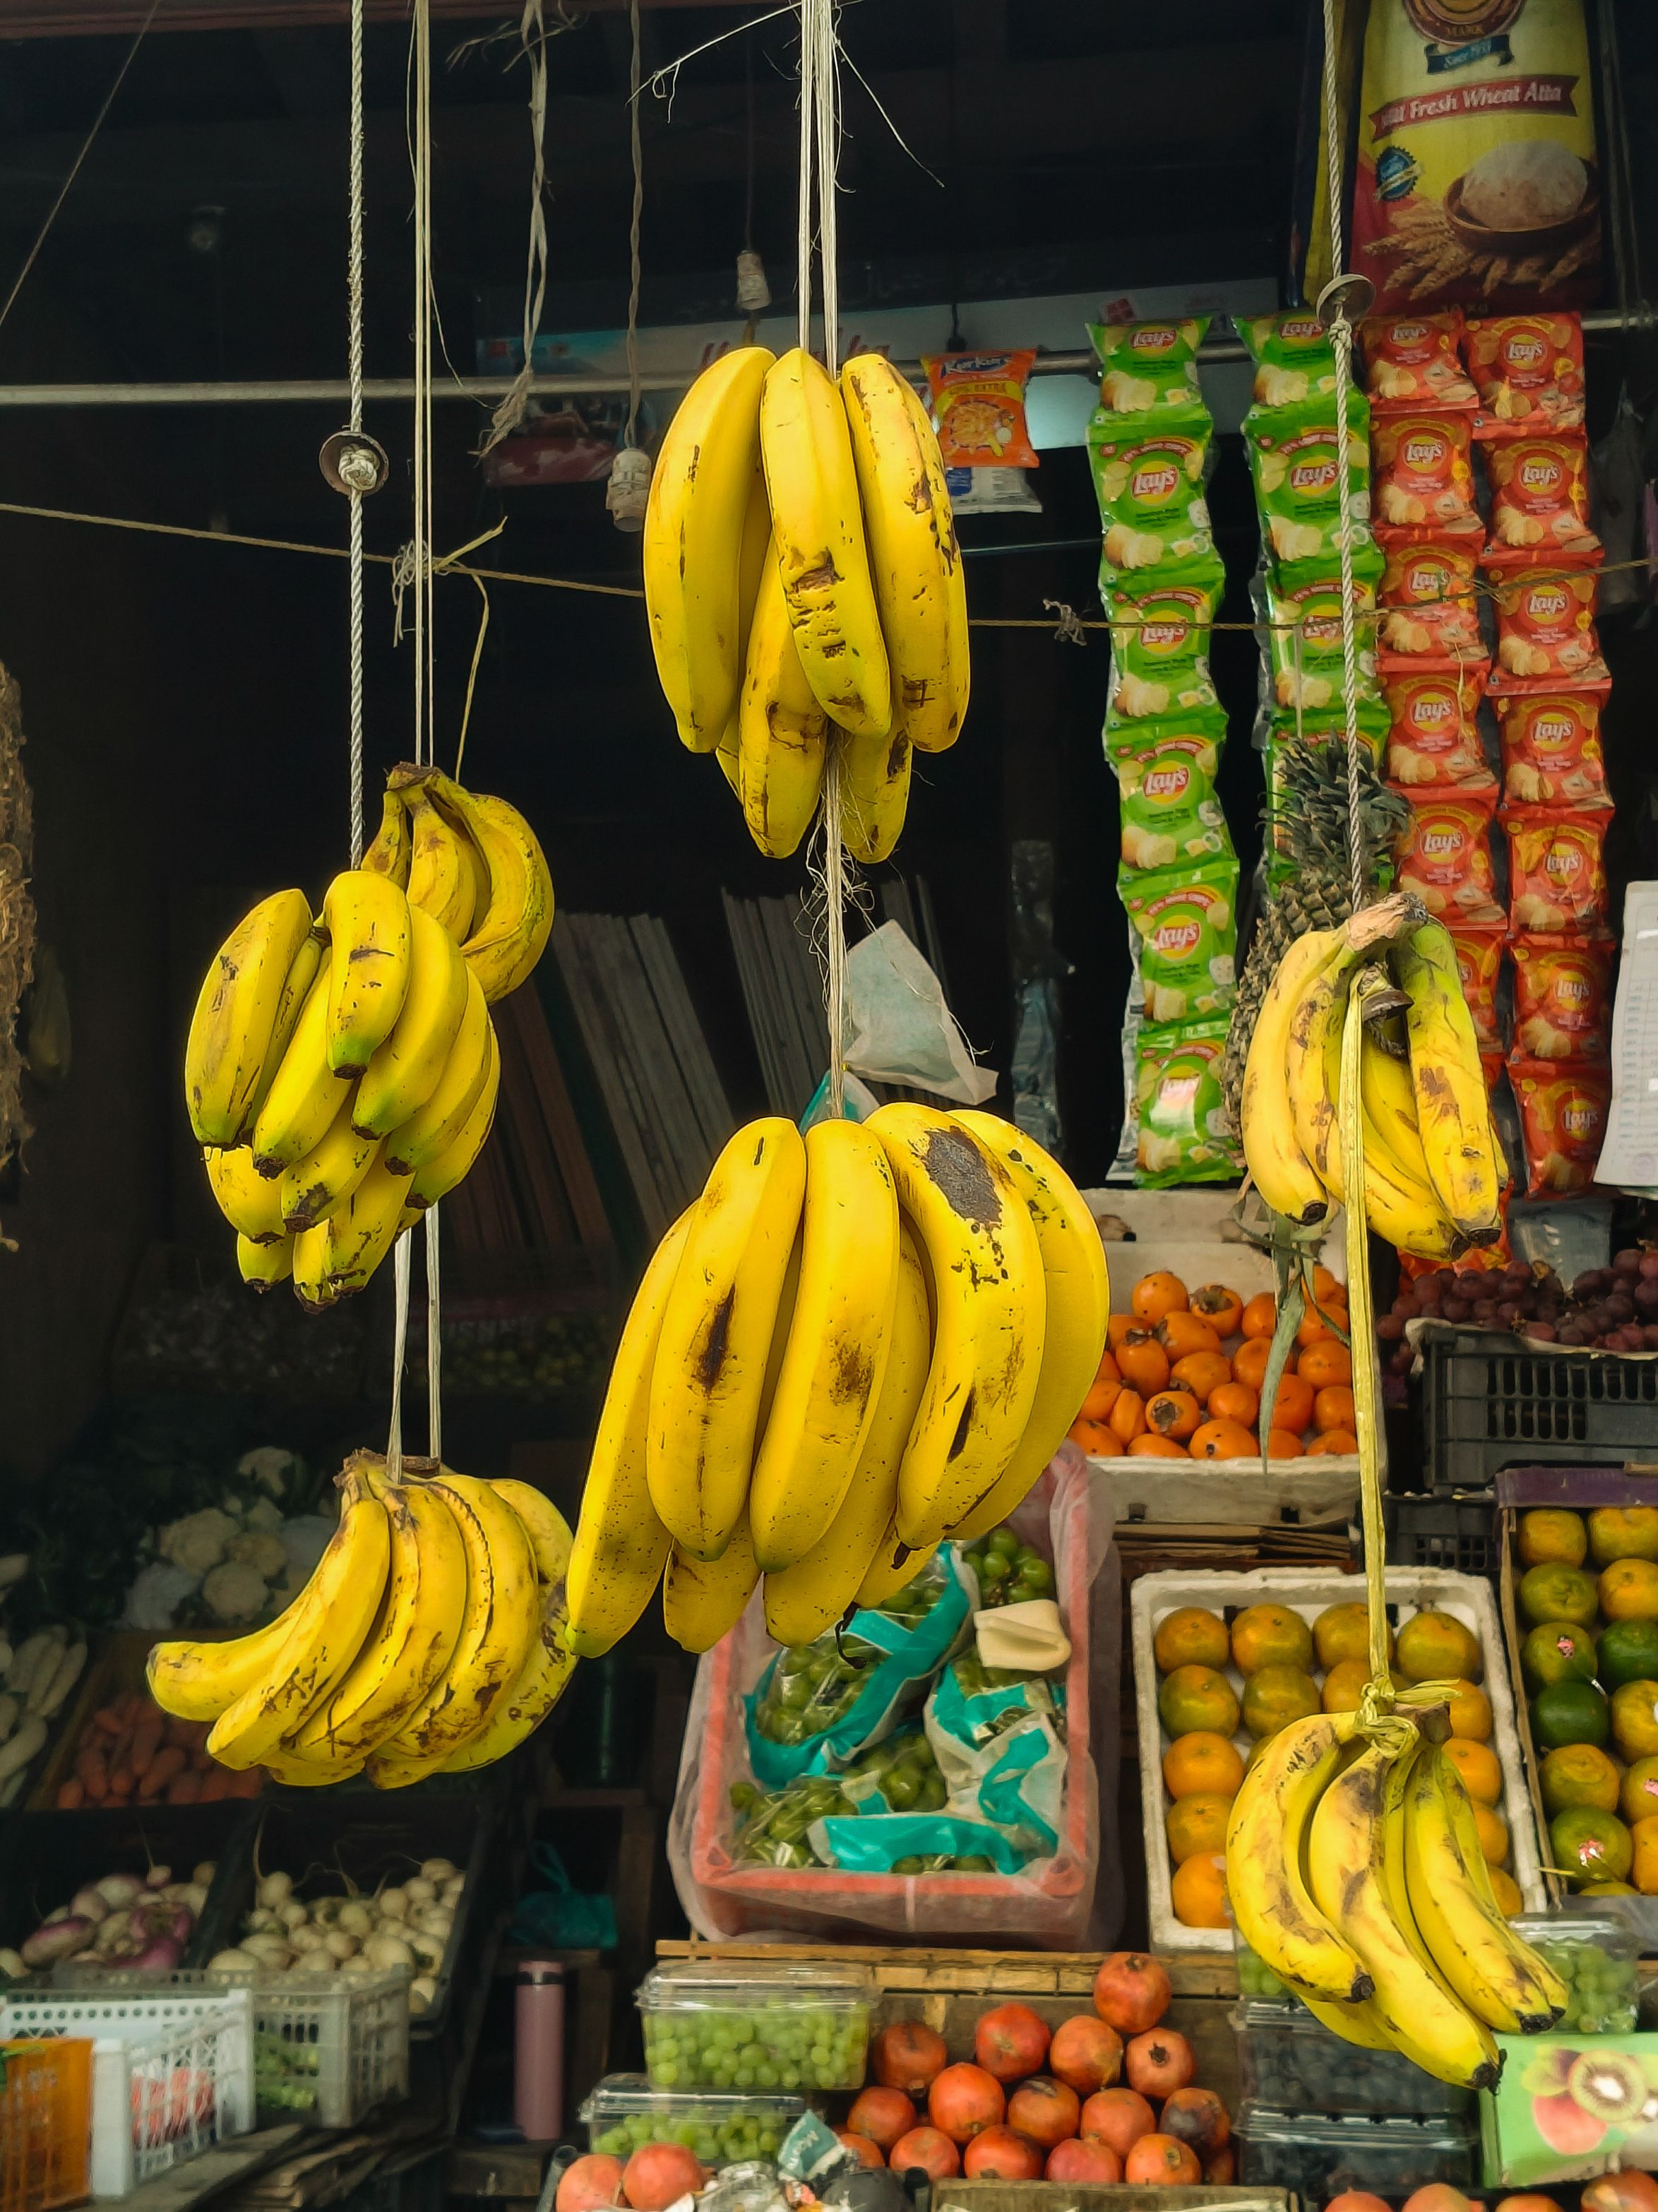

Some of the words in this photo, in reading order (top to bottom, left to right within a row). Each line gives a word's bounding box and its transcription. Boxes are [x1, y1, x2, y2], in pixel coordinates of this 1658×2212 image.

[1410, 94, 1457, 119] Fresh
[1463, 85, 1520, 107] Wheat
[1525, 81, 1562, 102] Atta
[1133, 329, 1177, 347] Lay's
[1280, 322, 1323, 338] Lay's
[1508, 340, 1542, 362] Lay's
[1405, 440, 1442, 463] Lay's
[1133, 466, 1176, 495] Lay's
[1292, 460, 1337, 487] Lay's
[1522, 465, 1558, 487] Lay's
[1528, 594, 1566, 616] Lay's
[1413, 700, 1451, 723] Lay's
[1534, 719, 1572, 742] Lay's
[1145, 766, 1188, 796] Lay's
[1424, 833, 1460, 855] Lay's
[1546, 850, 1580, 876] Lay's
[1157, 923, 1198, 950] Lay's
[1556, 977, 1590, 1002] Lay's
[1564, 1108, 1599, 1132] Lay's
